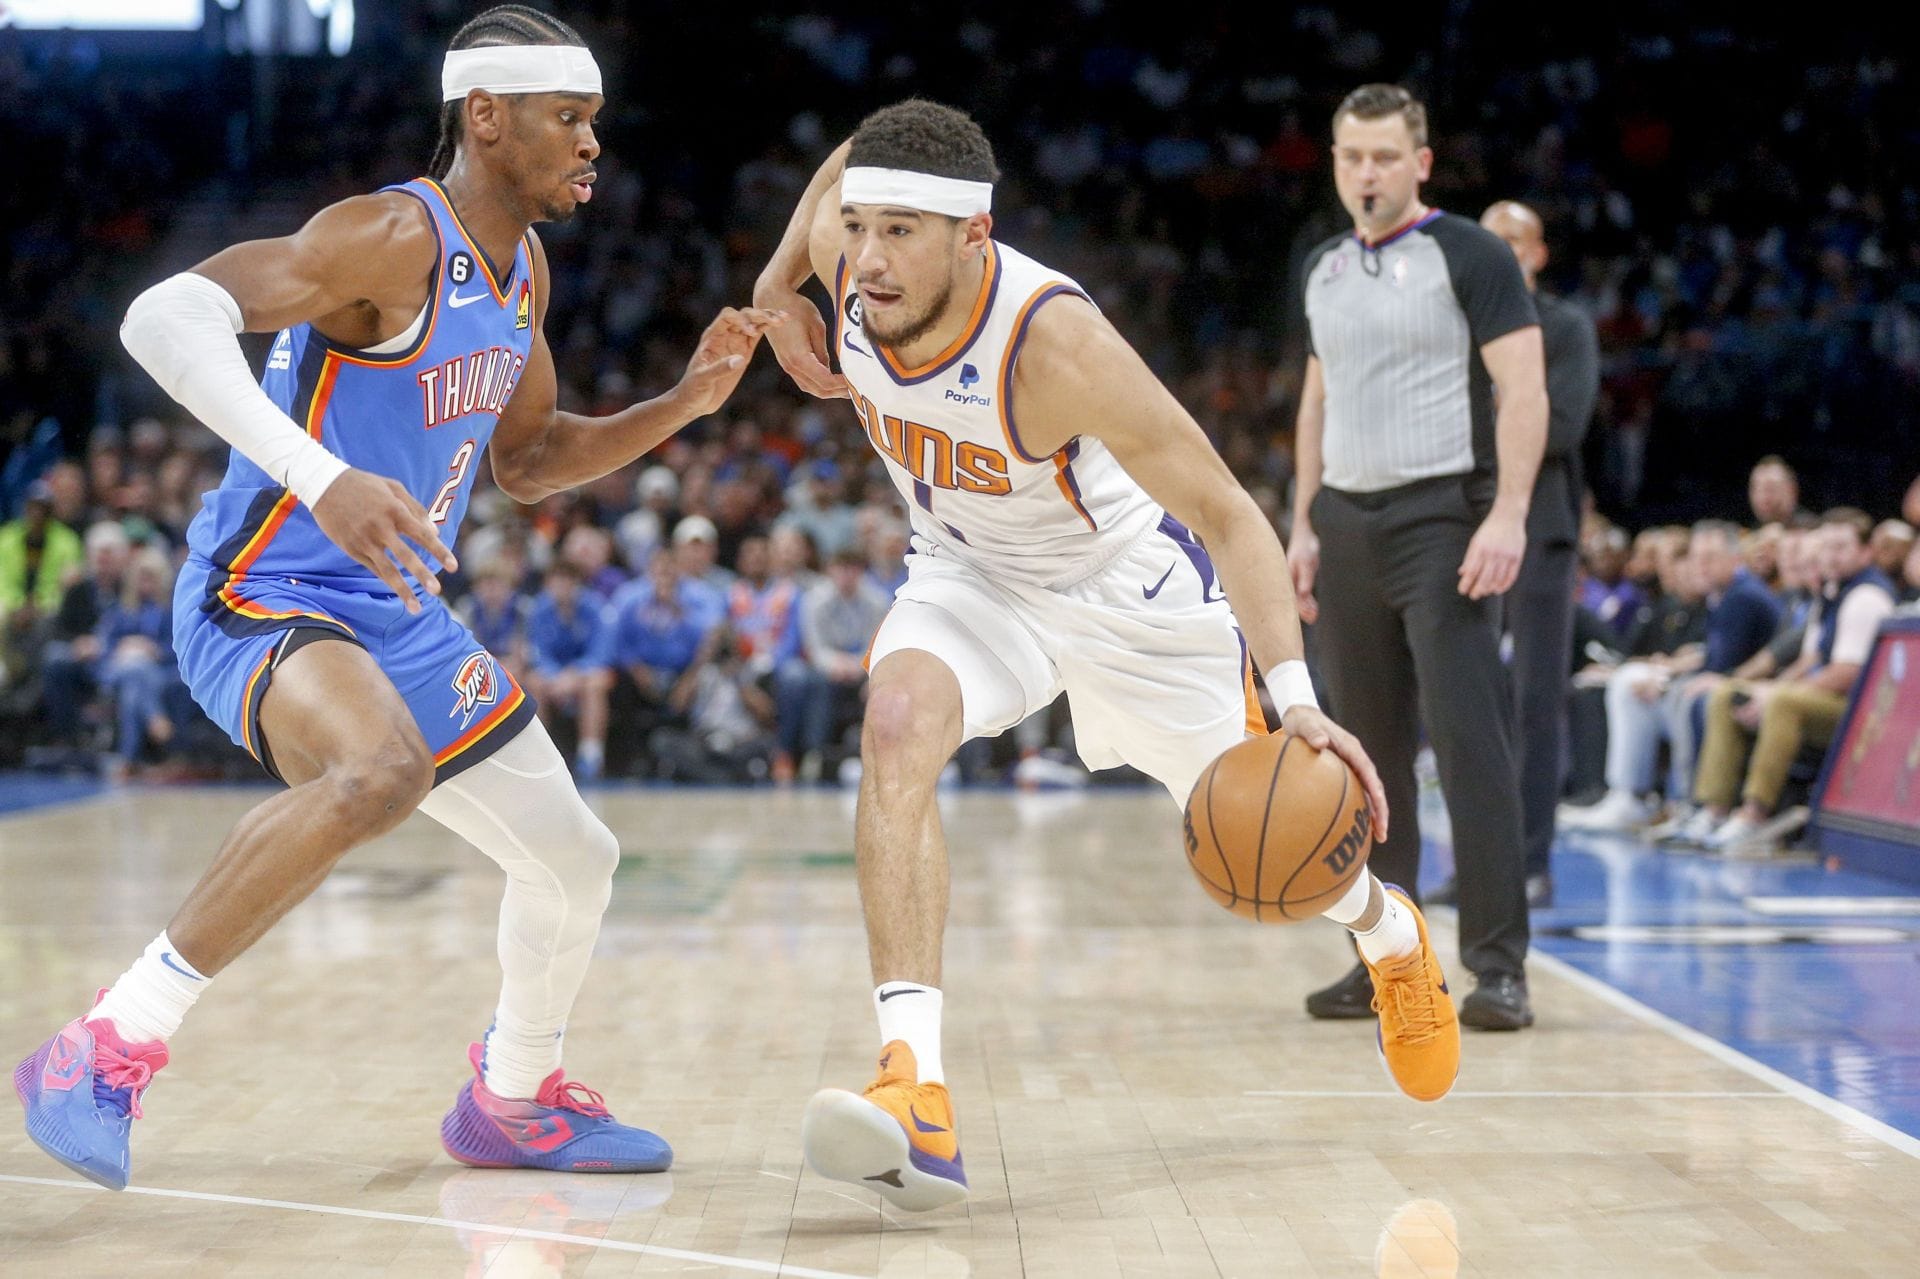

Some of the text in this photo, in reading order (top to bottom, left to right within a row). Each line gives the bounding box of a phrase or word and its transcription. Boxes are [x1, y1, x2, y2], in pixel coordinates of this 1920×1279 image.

[452, 255, 469, 282] 6
[944, 389, 991, 407] PayPal
[428, 438, 477, 526] 2
